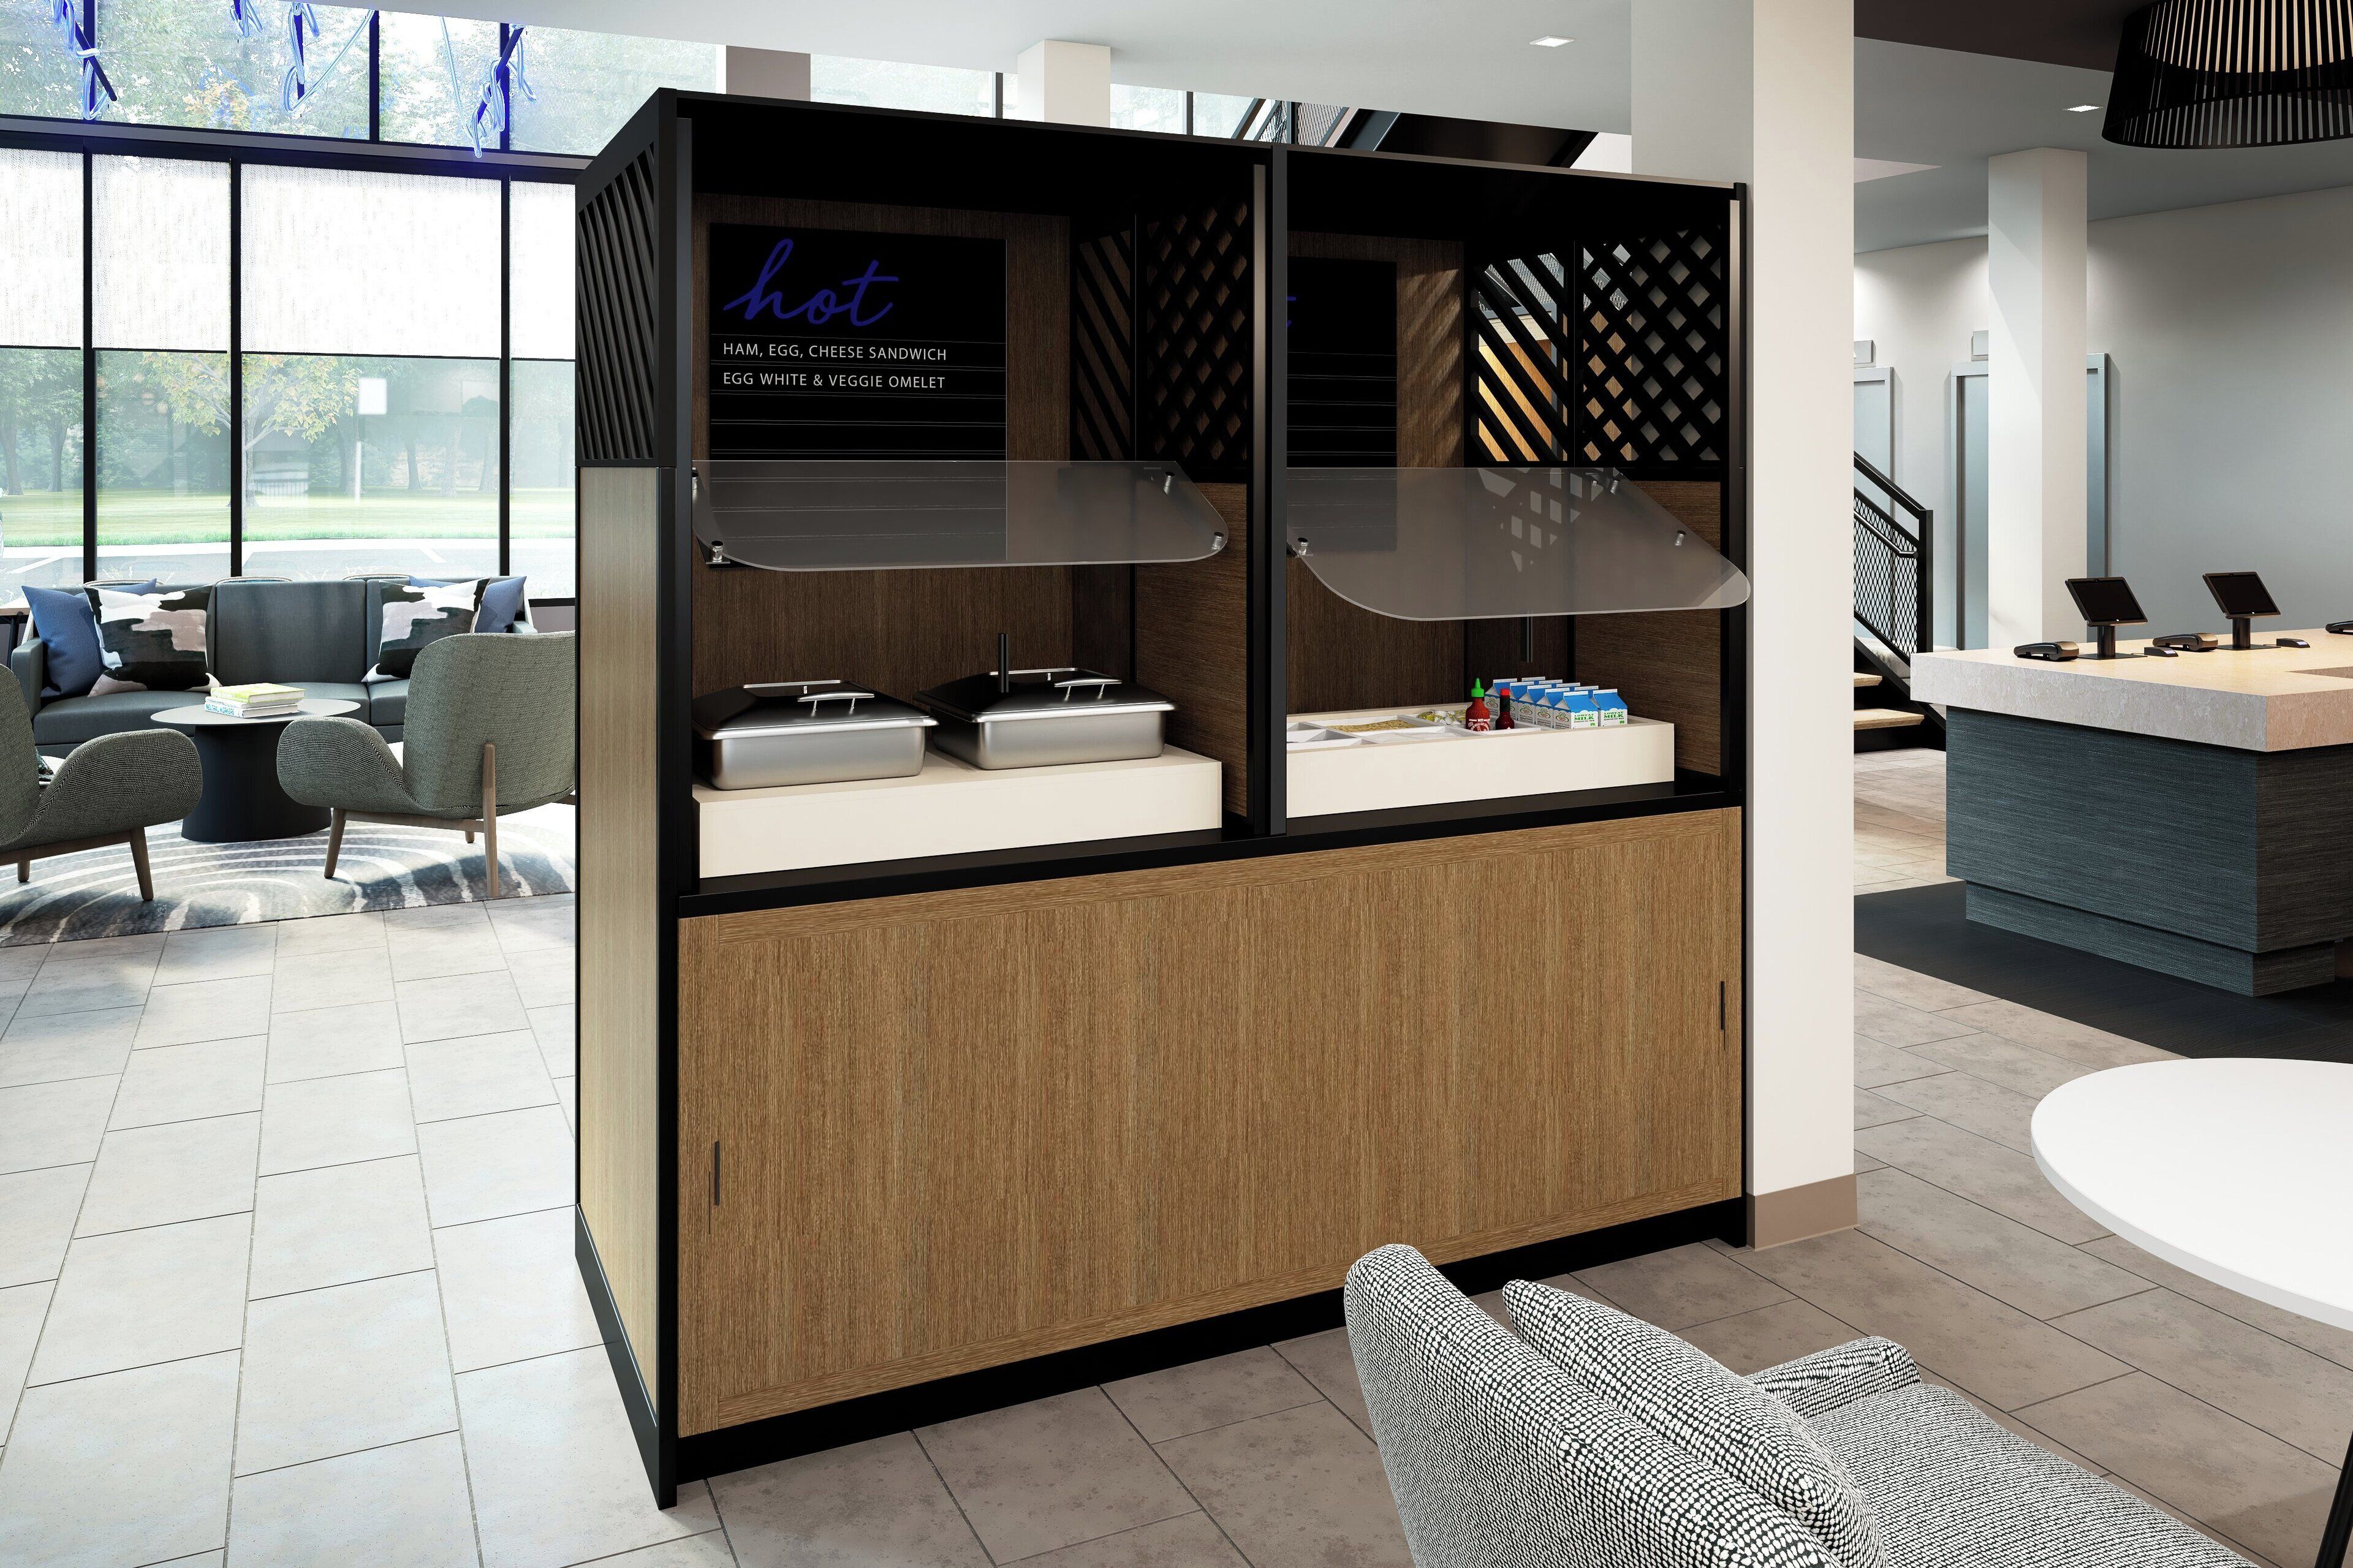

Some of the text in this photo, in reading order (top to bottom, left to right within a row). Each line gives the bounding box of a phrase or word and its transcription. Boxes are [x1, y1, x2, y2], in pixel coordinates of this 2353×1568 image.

[723, 238, 899, 327] hot
[724, 343, 946, 360] HAM, EGG, CHEESE SANDWICH
[724, 372, 945, 388] EGG WHITE & VEGGIE OMELET
